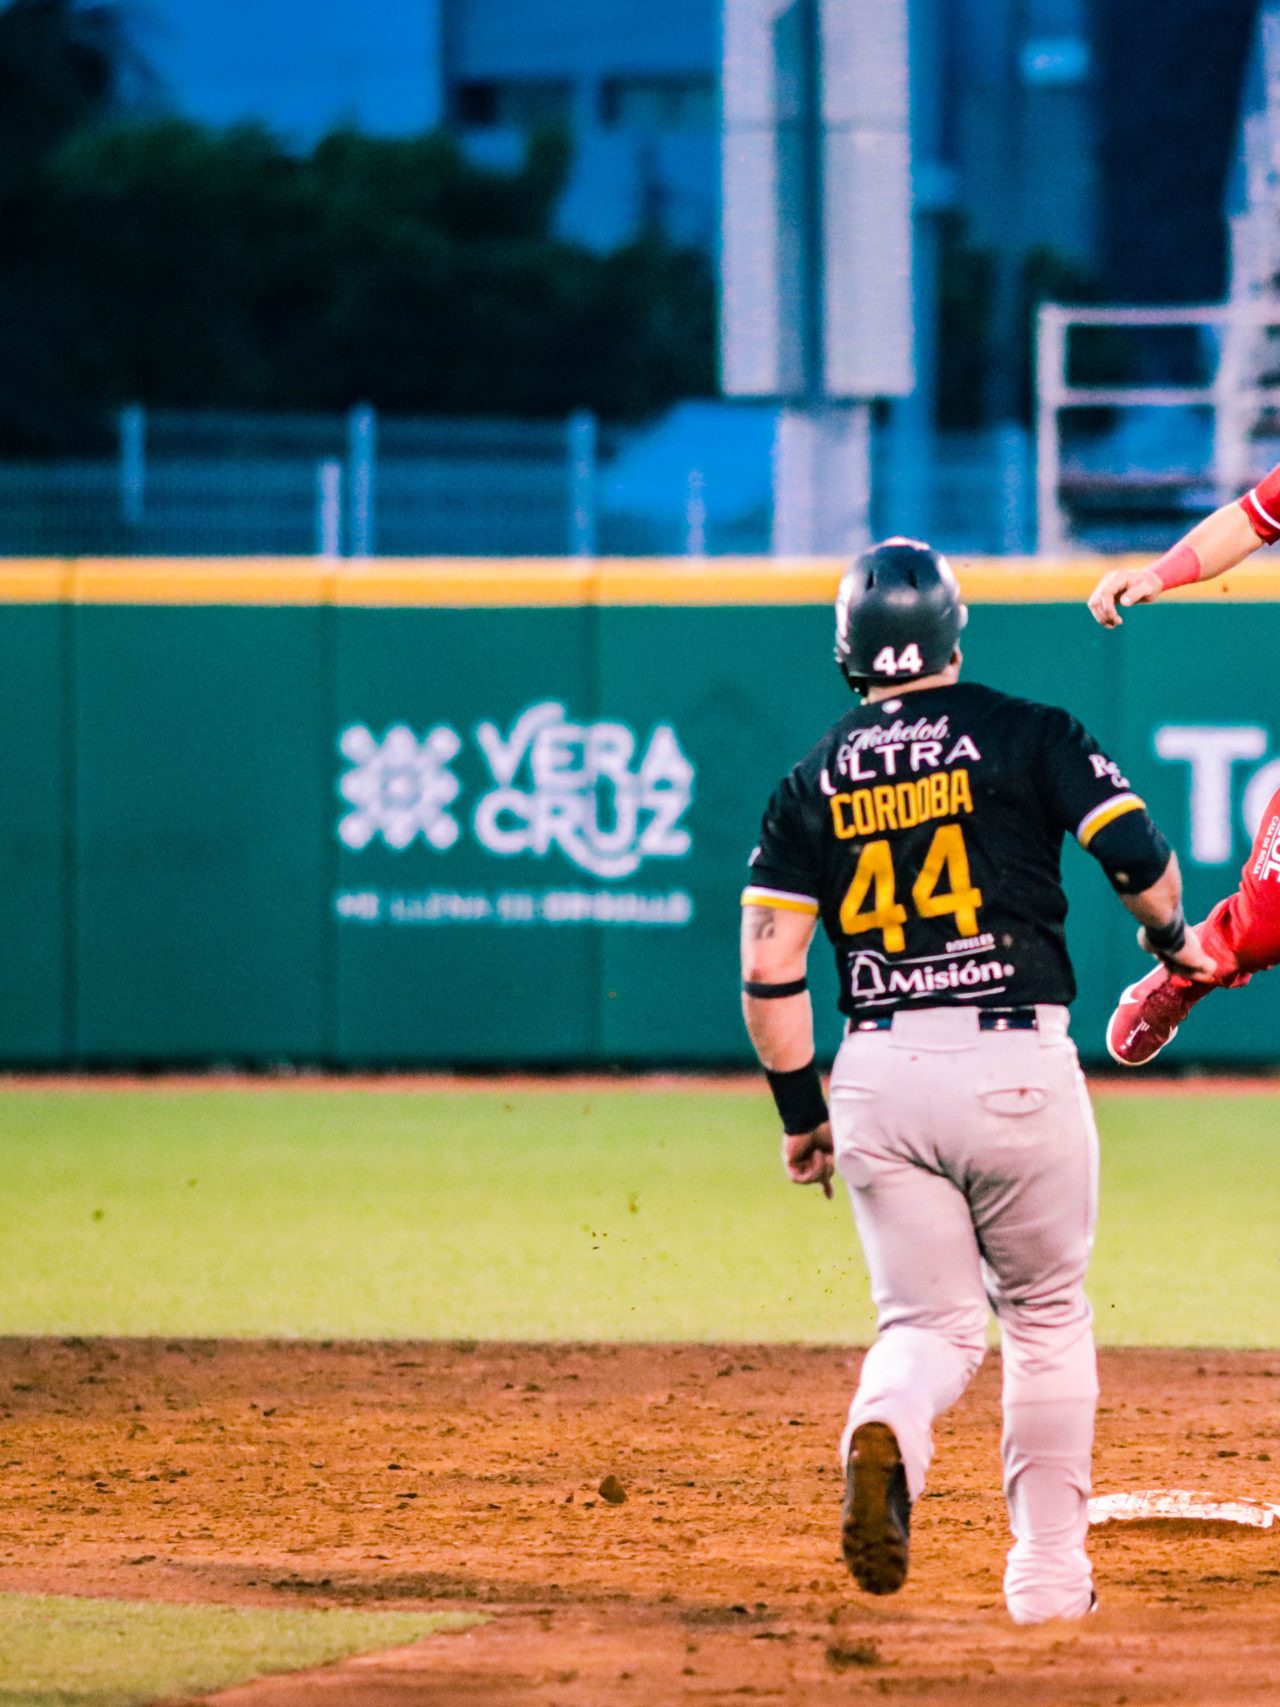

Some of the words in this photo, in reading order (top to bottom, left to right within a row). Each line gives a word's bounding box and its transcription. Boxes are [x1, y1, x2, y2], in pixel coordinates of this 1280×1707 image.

[872, 643, 923, 676] 44
[477, 702, 695, 788] VERA
[838, 715, 949, 763] Michelob
[474, 788, 692, 878] CRUZ
[830, 769, 974, 839] CORDOBA
[840, 823, 982, 953] 44
[889, 960, 1003, 993] Misión
